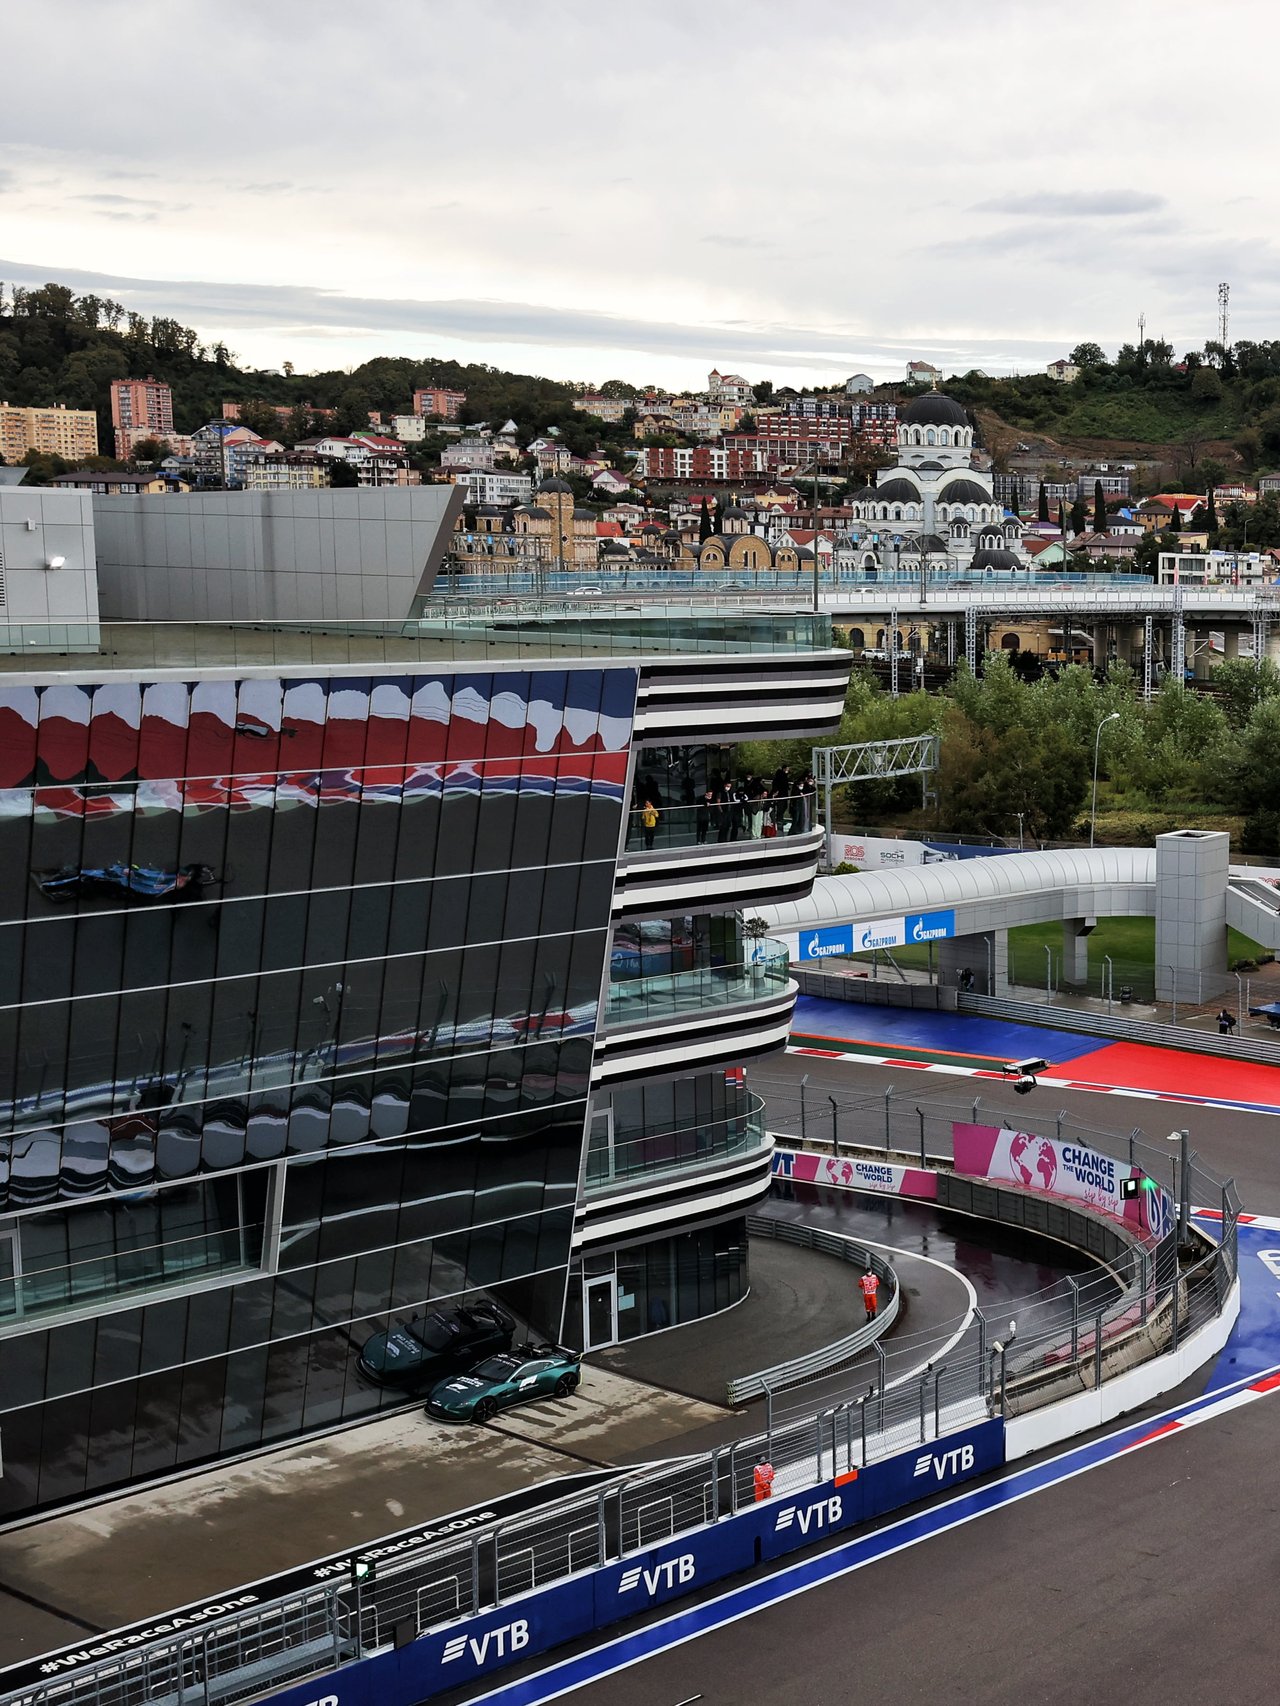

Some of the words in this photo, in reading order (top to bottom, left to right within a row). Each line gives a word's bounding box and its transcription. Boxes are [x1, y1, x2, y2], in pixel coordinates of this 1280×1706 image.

[872, 935, 897, 948] GAZPROM
[922, 928, 947, 939] GAZPROM
[819, 944, 845, 956] GAZPROM
[855, 1163, 893, 1176] CHANGE
[1062, 1147, 1114, 1178] CHANGE
[864, 1173, 893, 1183] WORLD
[1063, 1164, 1074, 1172] THE
[1075, 1168, 1114, 1194] WORLD
[934, 1444, 975, 1480] VTB
[797, 1496, 842, 1534] VTB
[643, 1554, 695, 1596] VTB
[40, 1595, 259, 1673] #WeRaceAsOne
[470, 1619, 530, 1665] VTB
